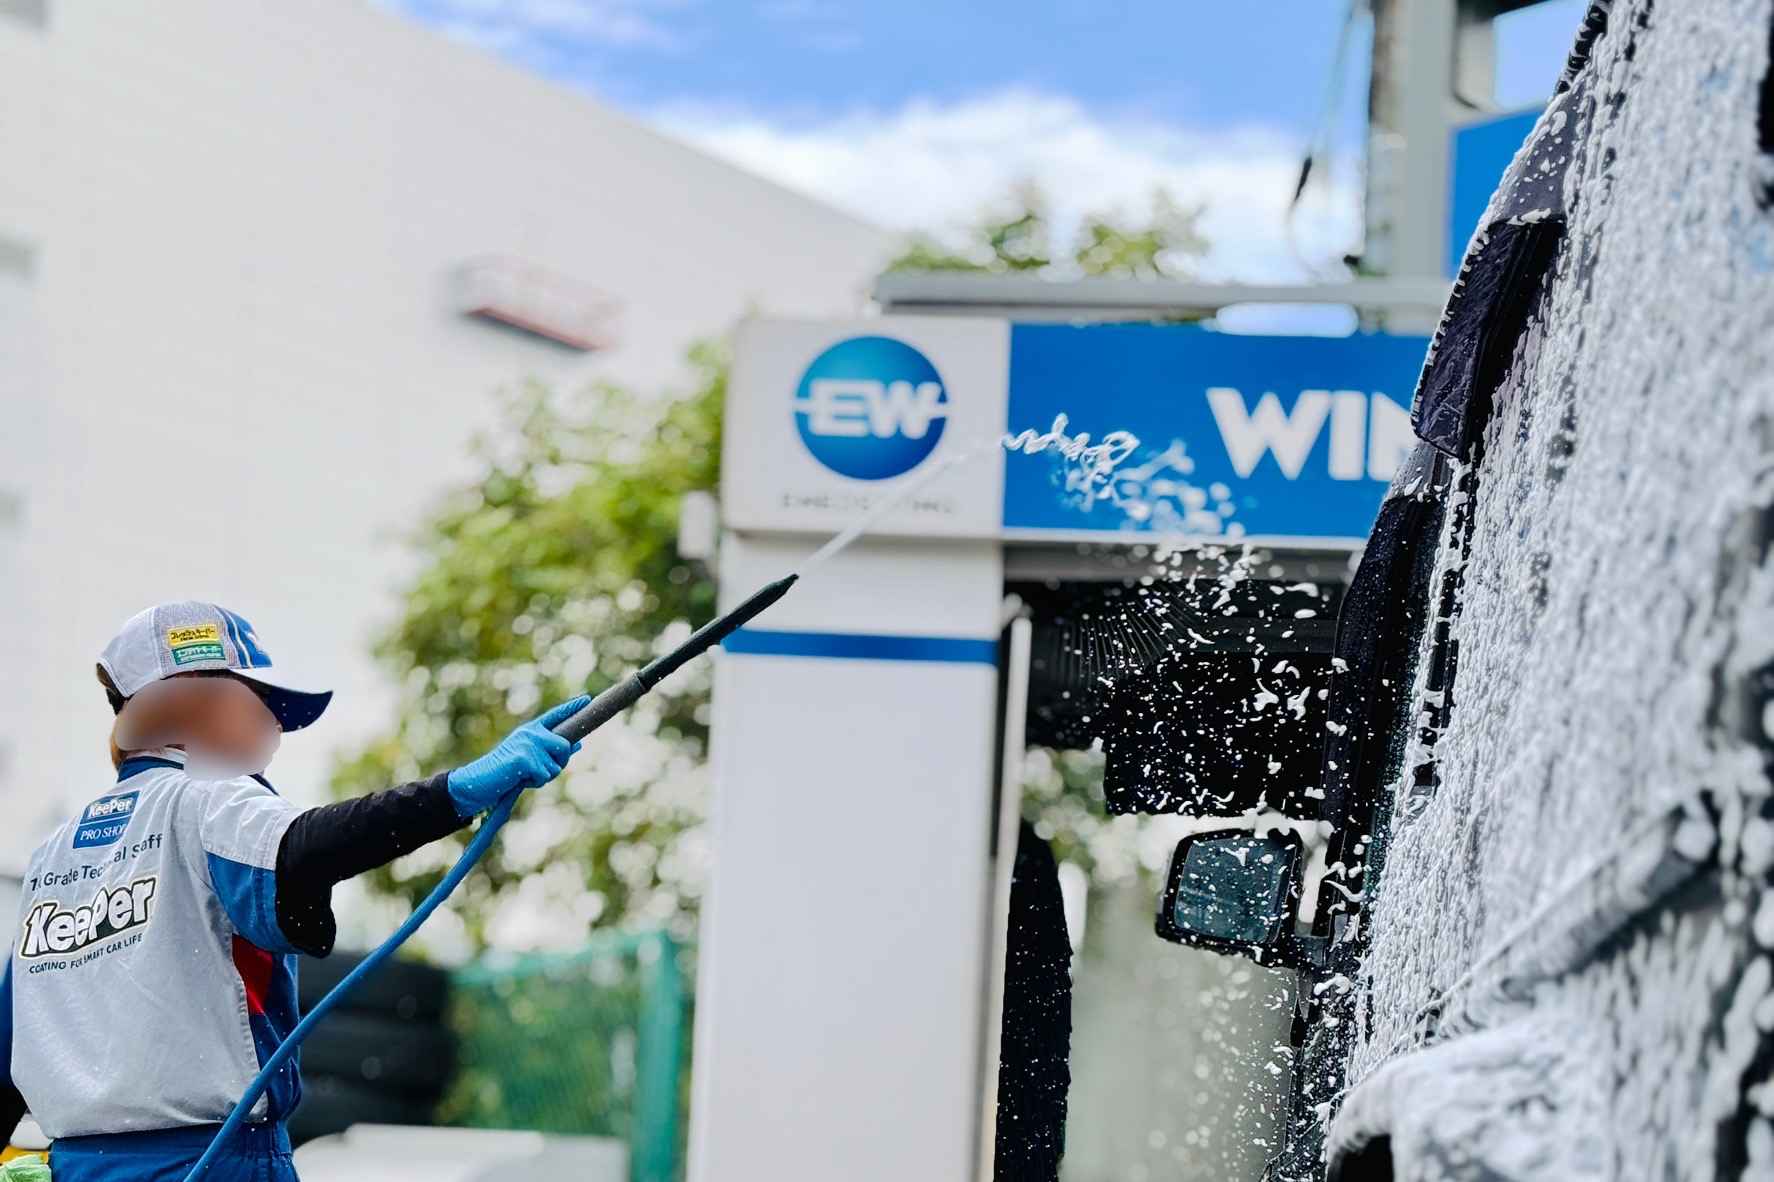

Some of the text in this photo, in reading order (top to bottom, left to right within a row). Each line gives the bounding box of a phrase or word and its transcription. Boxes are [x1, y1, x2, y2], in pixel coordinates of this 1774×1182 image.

[805, 377, 944, 440] EW
[80, 824, 127, 840] PRO SHOP
[21, 877, 156, 958] KeePer
[29, 961, 67, 974] COATING
[83, 948, 104, 964] SMART
[106, 942, 122, 954] CAR
[124, 933, 143, 947] LIFE
